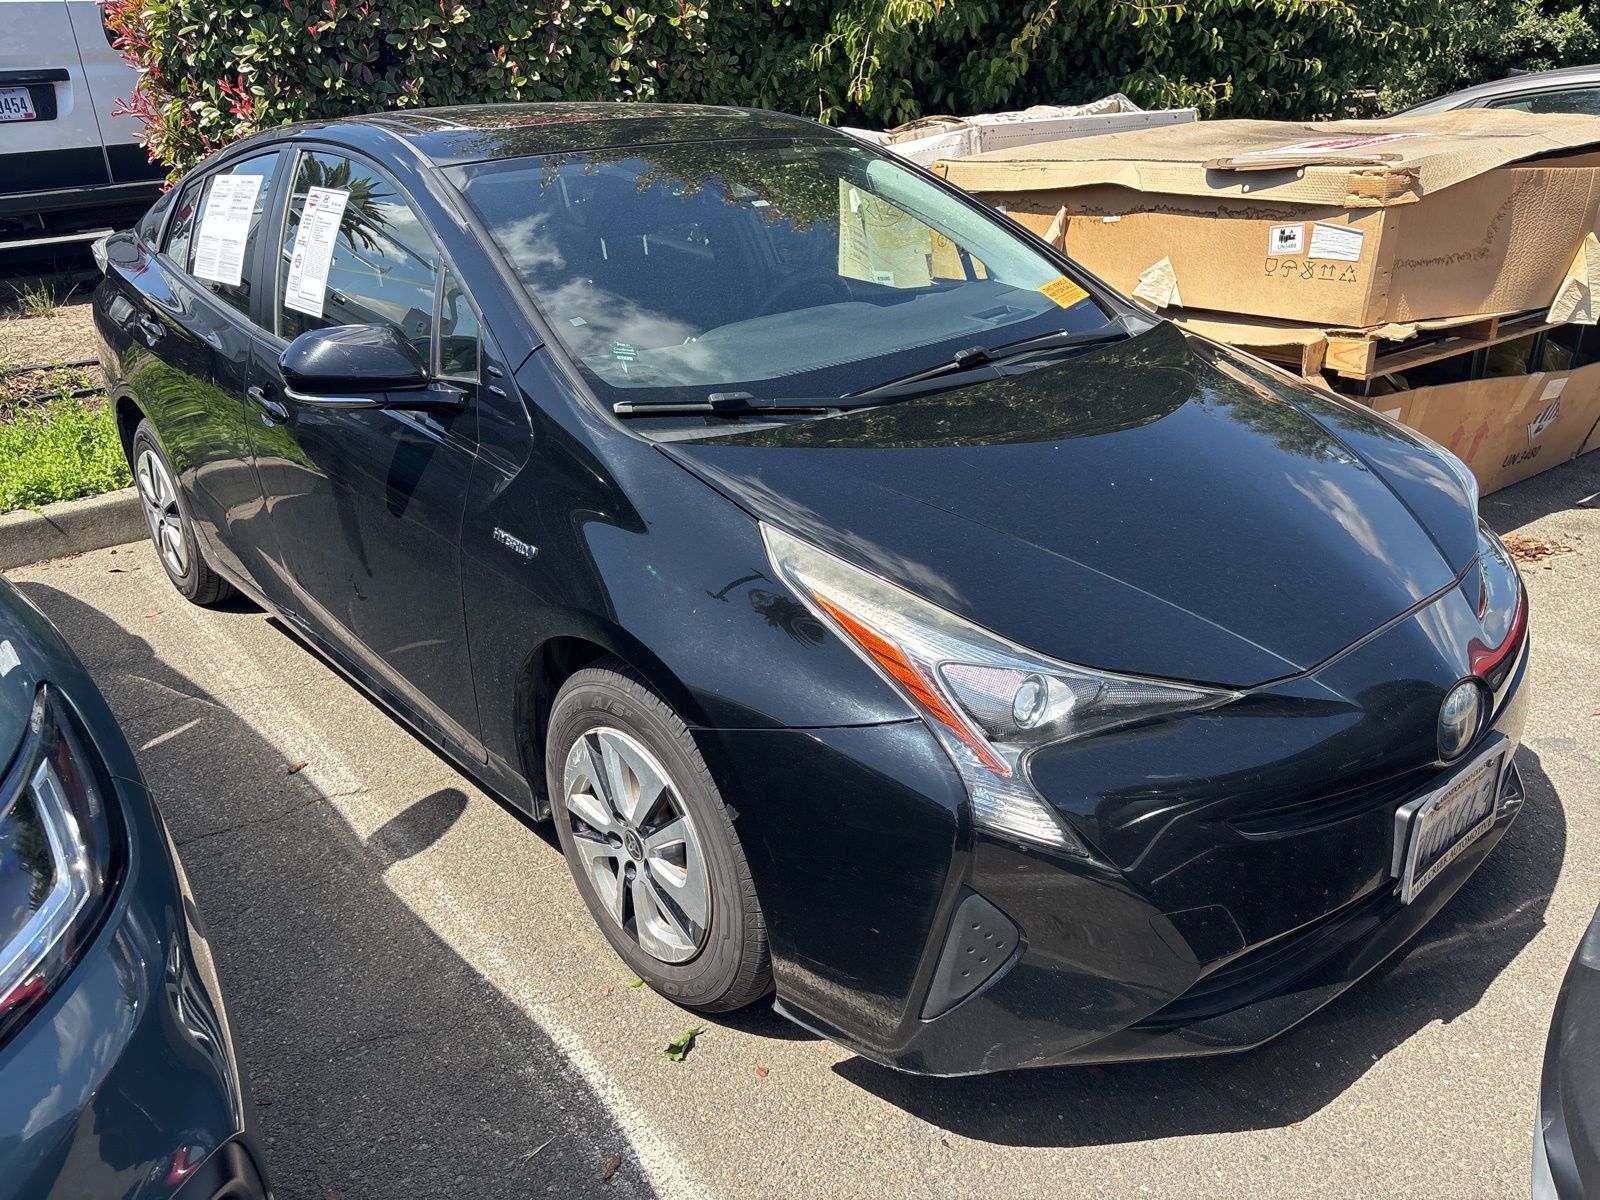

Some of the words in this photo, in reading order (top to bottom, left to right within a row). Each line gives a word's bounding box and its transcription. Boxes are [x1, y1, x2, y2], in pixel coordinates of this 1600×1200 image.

[492, 526, 531, 558] HYBRID
[1428, 857, 1448, 880] CREEK
[1449, 818, 1492, 861] AUTOMOTIVE
